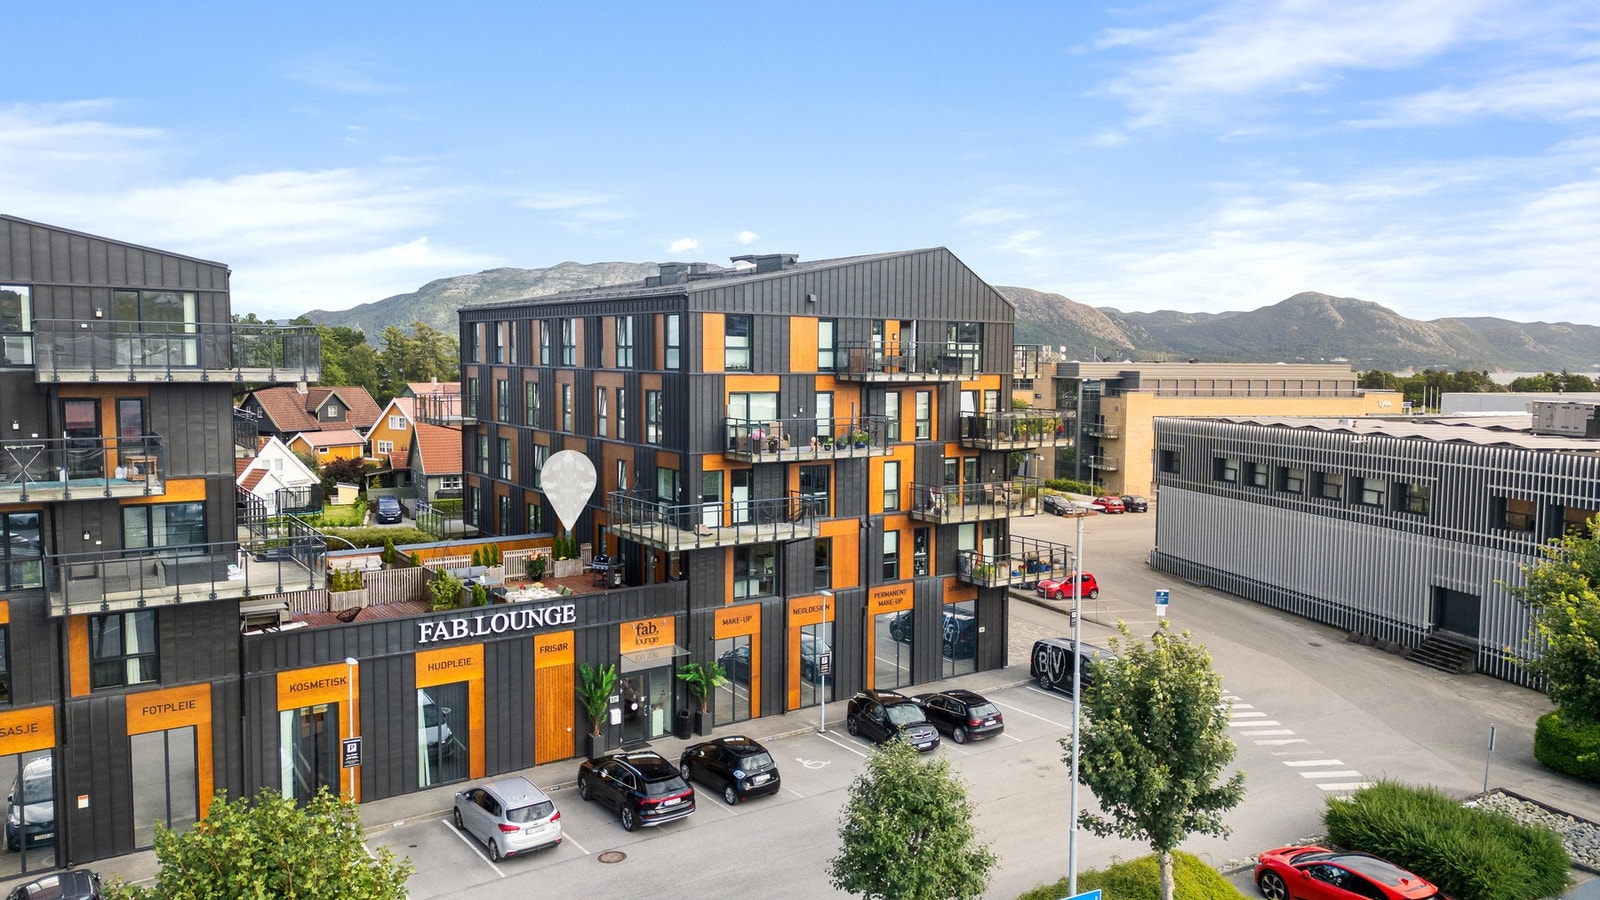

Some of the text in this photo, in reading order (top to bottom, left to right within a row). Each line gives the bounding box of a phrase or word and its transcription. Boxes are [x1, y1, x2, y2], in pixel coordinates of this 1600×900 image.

[874, 588, 907, 599] PERMANENT
[878, 598, 903, 607] MAKE-UP
[418, 604, 577, 643] FAB.LOUNGE
[722, 615, 752, 626] MAKE-UP
[636, 621, 659, 636] fab.
[636, 636, 659, 646] lounge
[539, 643, 569, 654] FRISØR
[427, 657, 472, 672] HUDPLEIE
[289, 676, 347, 693] KOSMETISK
[142, 700, 196, 716] FOTPLEIE
